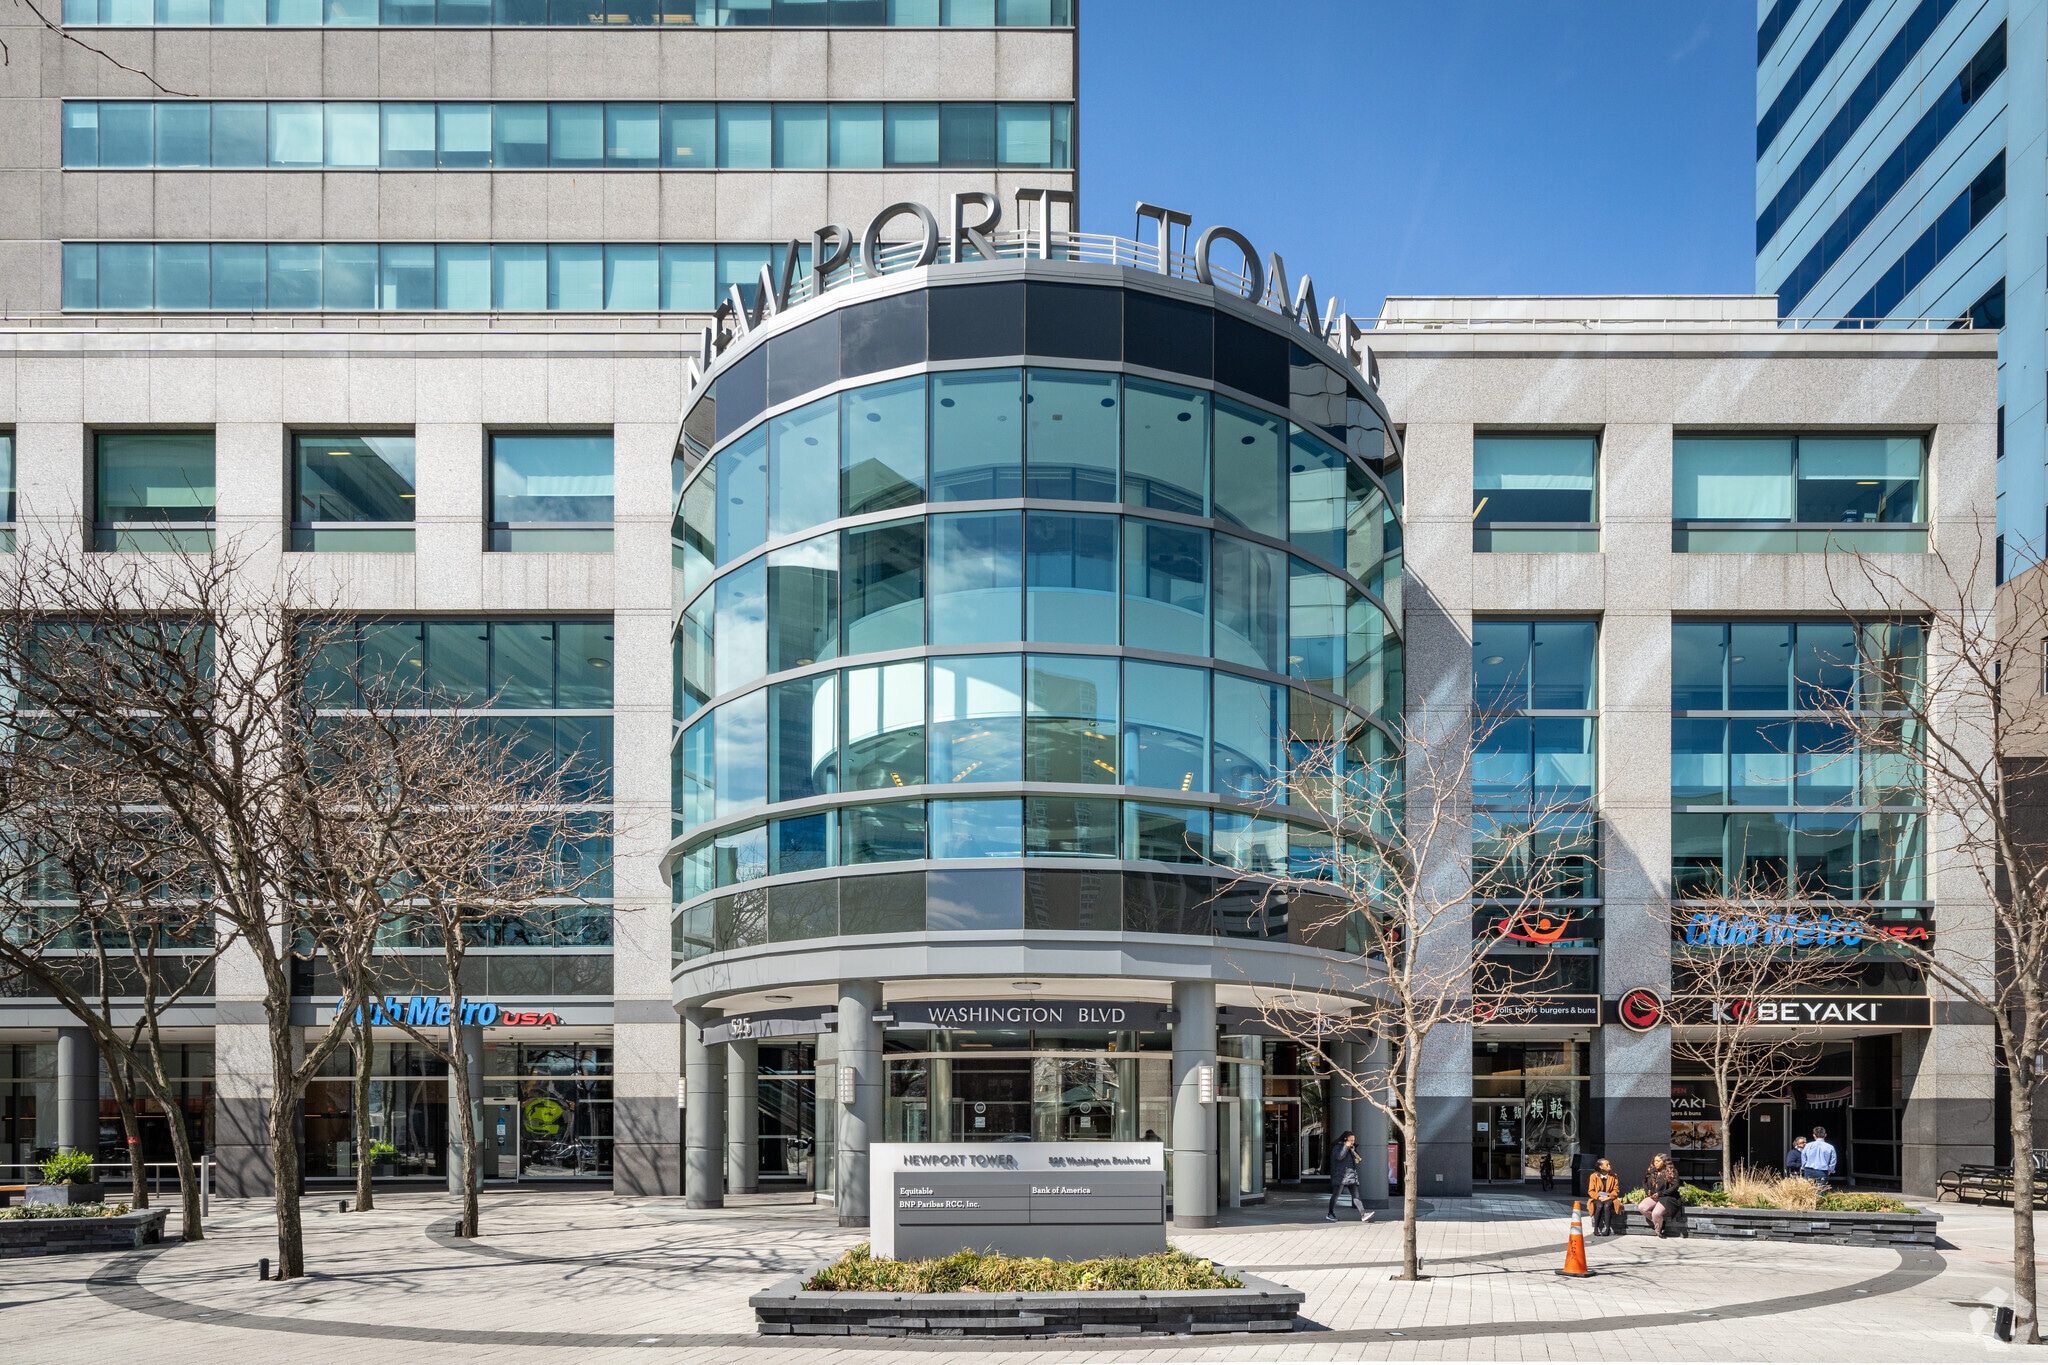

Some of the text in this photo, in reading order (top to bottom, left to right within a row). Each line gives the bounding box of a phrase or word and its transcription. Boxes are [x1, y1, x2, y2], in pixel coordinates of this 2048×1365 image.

[688, 187, 1074, 394] NEWPORT
[928, 1007, 1126, 1023] WASHINGTON BLVD
[1496, 1006, 1513, 1014] rolls
[1540, 1006, 1569, 1015] burgers
[1570, 1006, 1576, 1014] &
[1577, 1006, 1596, 1014] buns
[1712, 1002, 1876, 1021] KOBEYAKI
[502, 1012, 557, 1025] USA
[730, 1018, 751, 1036] 525
[903, 1154, 1016, 1167] NEWPORT TOWER
[1065, 1156, 1112, 1167] Washington
[1112, 1156, 1151, 1165] Boulevard
[899, 1187, 934, 1196] Equitable
[1032, 1186, 1091, 1194] Bank of America
[899, 1200, 980, 1209] BNP Paribas RCC, Inc.
